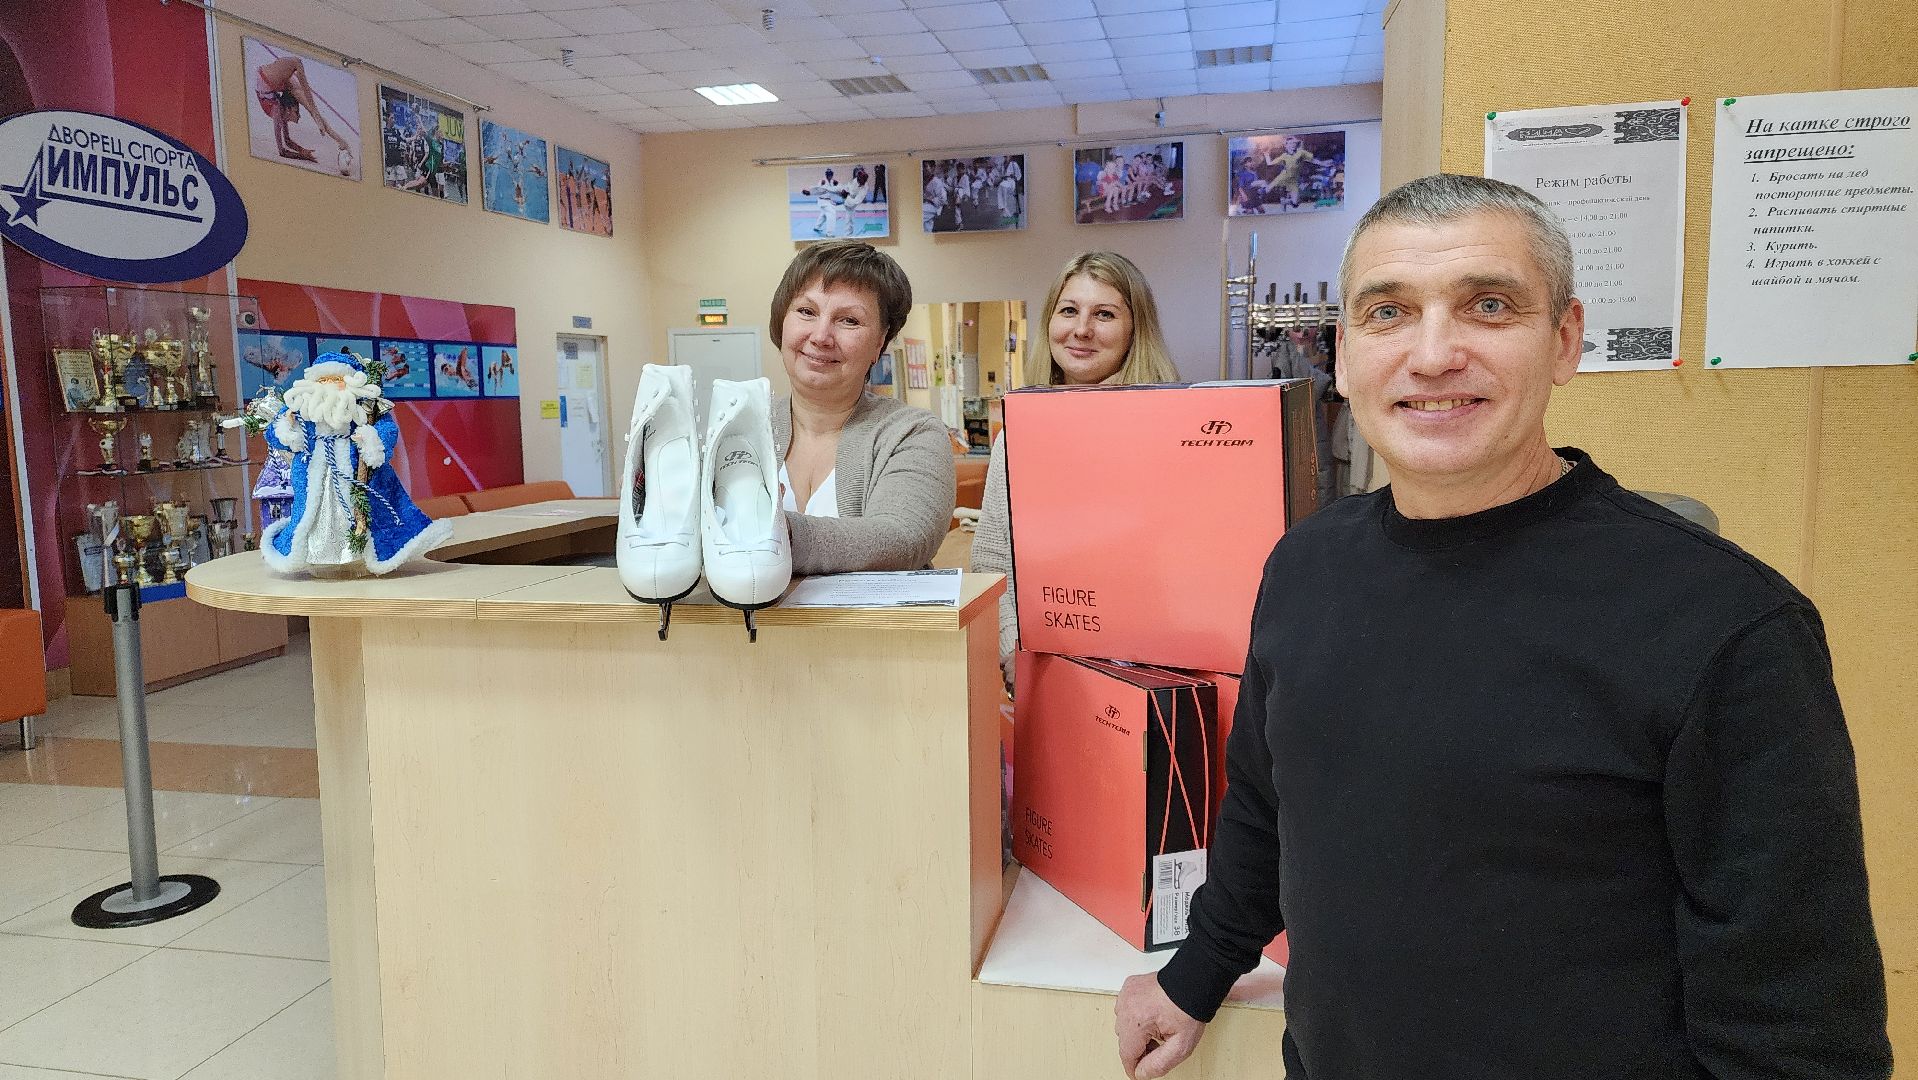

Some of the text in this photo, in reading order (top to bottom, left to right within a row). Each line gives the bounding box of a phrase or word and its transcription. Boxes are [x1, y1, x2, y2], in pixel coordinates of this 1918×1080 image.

[1746, 114, 1911, 134] На катке строго
[47, 123, 197, 171] ДВОРЕЦ СПОРТА
[1744, 144, 1855, 162] запрещено:
[47, 145, 199, 211] ИМПУЛЬС
[1536, 174, 1632, 188] Режим работы
[1751, 168, 1869, 184] 1. Бросать на лед
[1755, 185, 1914, 201] посторонние предметы.
[1748, 203, 1907, 218] 2. Распивать спиртные
[1753, 223, 1814, 235] напитки.
[1746, 240, 1818, 253] 3. Курить.
[1746, 255, 1881, 270] 4. Играть в хоккей с
[1751, 274, 1860, 286] шайбой и мячом.
[1180, 439, 1254, 447] TECH TEAM
[1042, 586, 1097, 607] FIGURE
[1044, 611, 1101, 632] SKATES
[1025, 807, 1053, 837] FIGURE
[1024, 829, 1053, 860] SKATES
[1173, 925, 1181, 936] 38
